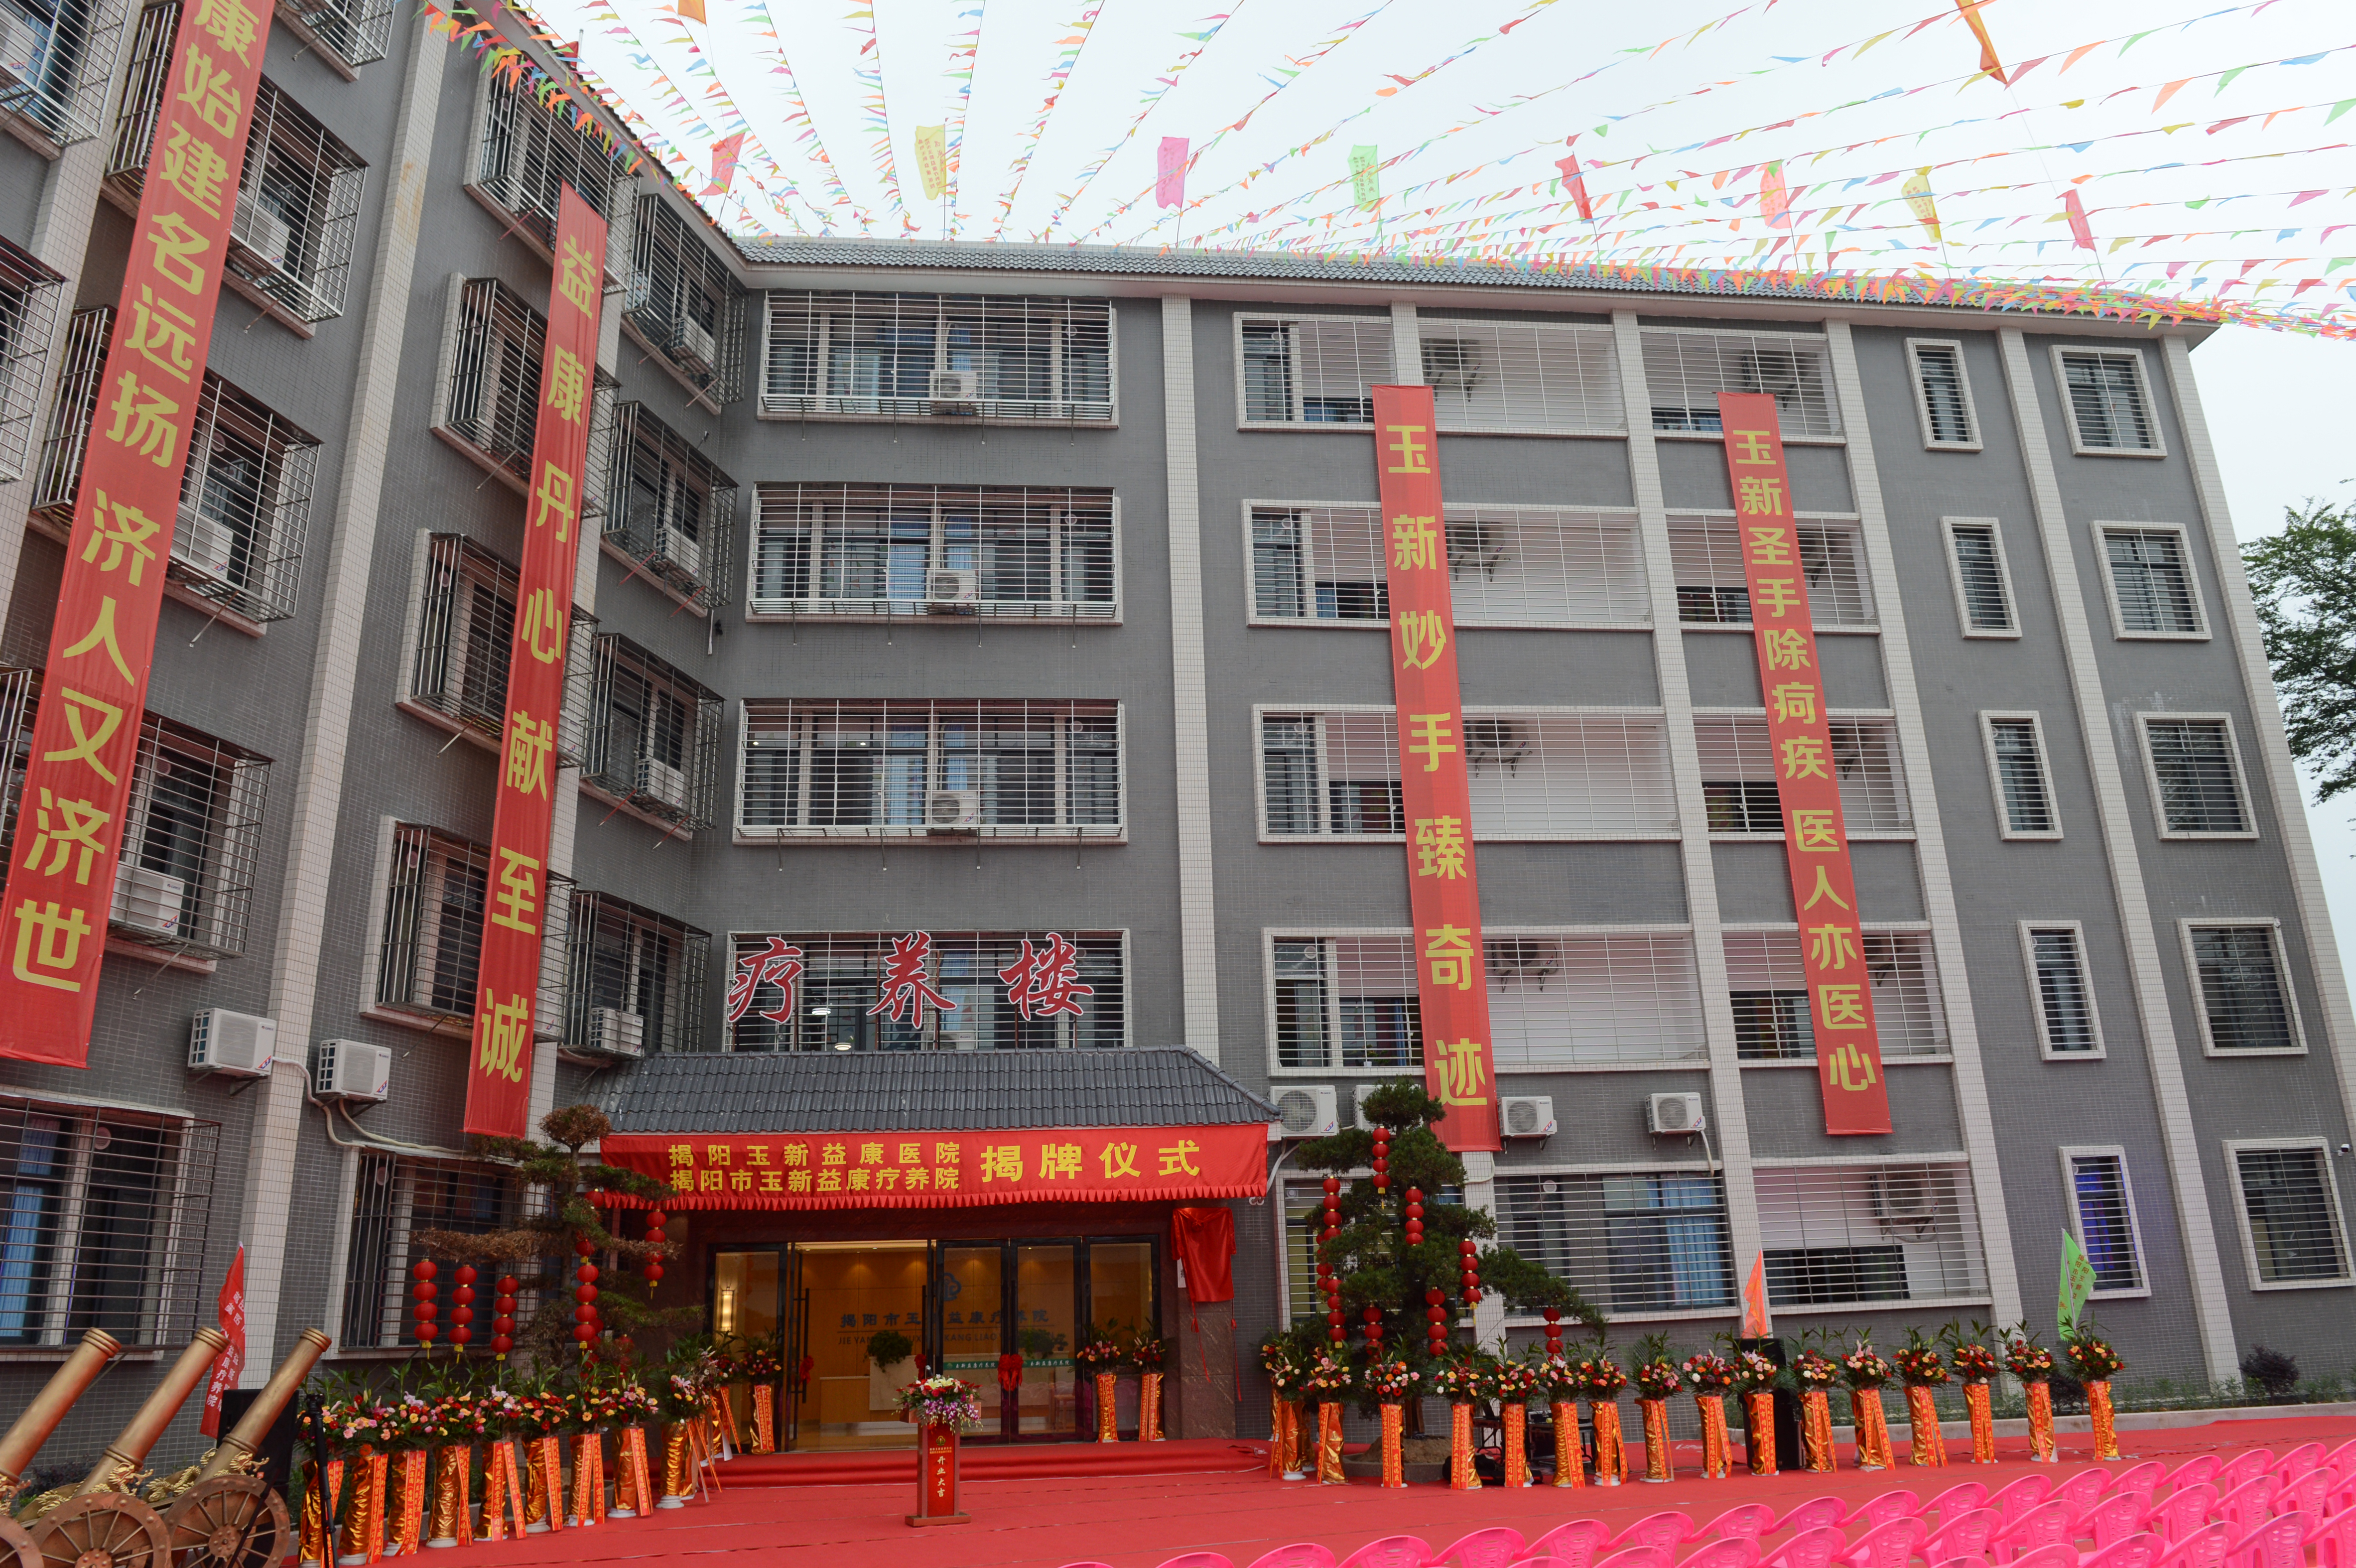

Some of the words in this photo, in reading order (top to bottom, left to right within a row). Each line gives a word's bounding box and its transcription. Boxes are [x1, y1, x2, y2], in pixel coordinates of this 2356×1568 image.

[479, 235, 597, 1082] 益康丹心献至诚
[1386, 425, 1488, 1106] 玉新妙手臻奇迹
[1733, 430, 1876, 1091] 玉新圣手除疴疾医人亦医心
[727, 930, 1094, 1030] 疗养楼
[668, 1142, 960, 1167] 揭阳玉新益康医院
[980, 1139, 1200, 1182] 揭牌仪式
[670, 1167, 960, 1192] 揭阳市玉新益康疗养院
[840, 1309, 1049, 1328] 揭阳市玉益康疗养院
[936, 1455, 946, 1498] 开业大吉
